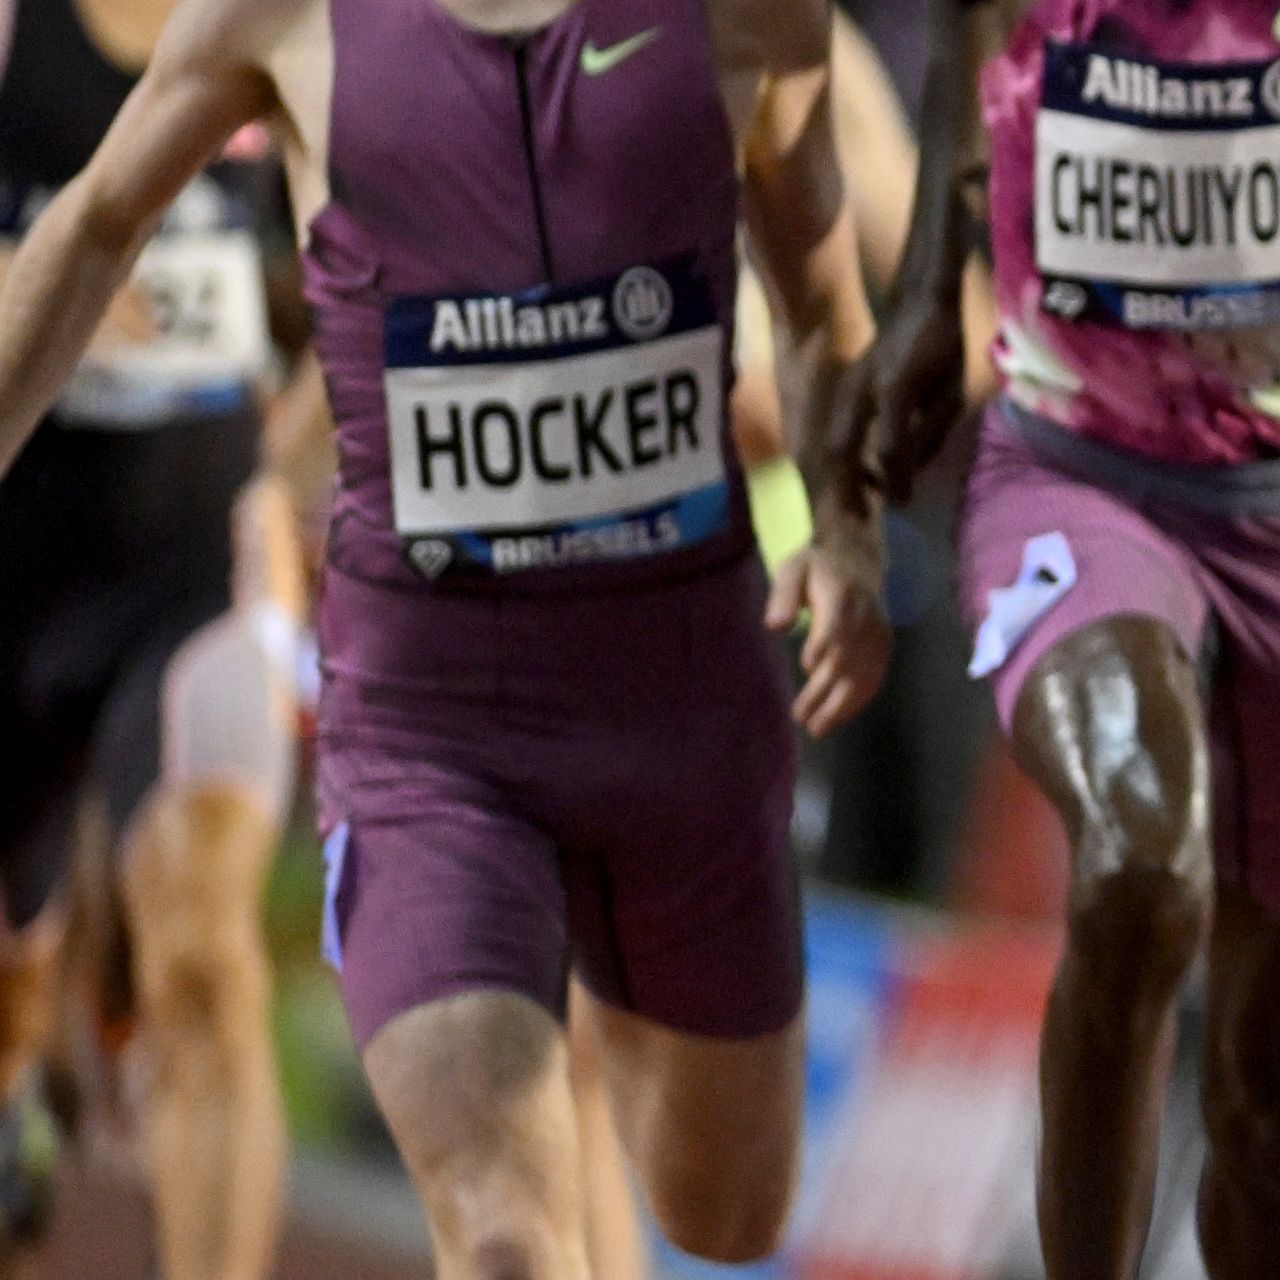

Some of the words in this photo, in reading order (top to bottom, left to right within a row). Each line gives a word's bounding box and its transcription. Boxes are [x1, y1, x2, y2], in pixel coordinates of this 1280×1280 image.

[1082, 54, 1255, 116] Allianz
[429, 294, 609, 353] Allianz
[414, 369, 700, 490] HOCKER
